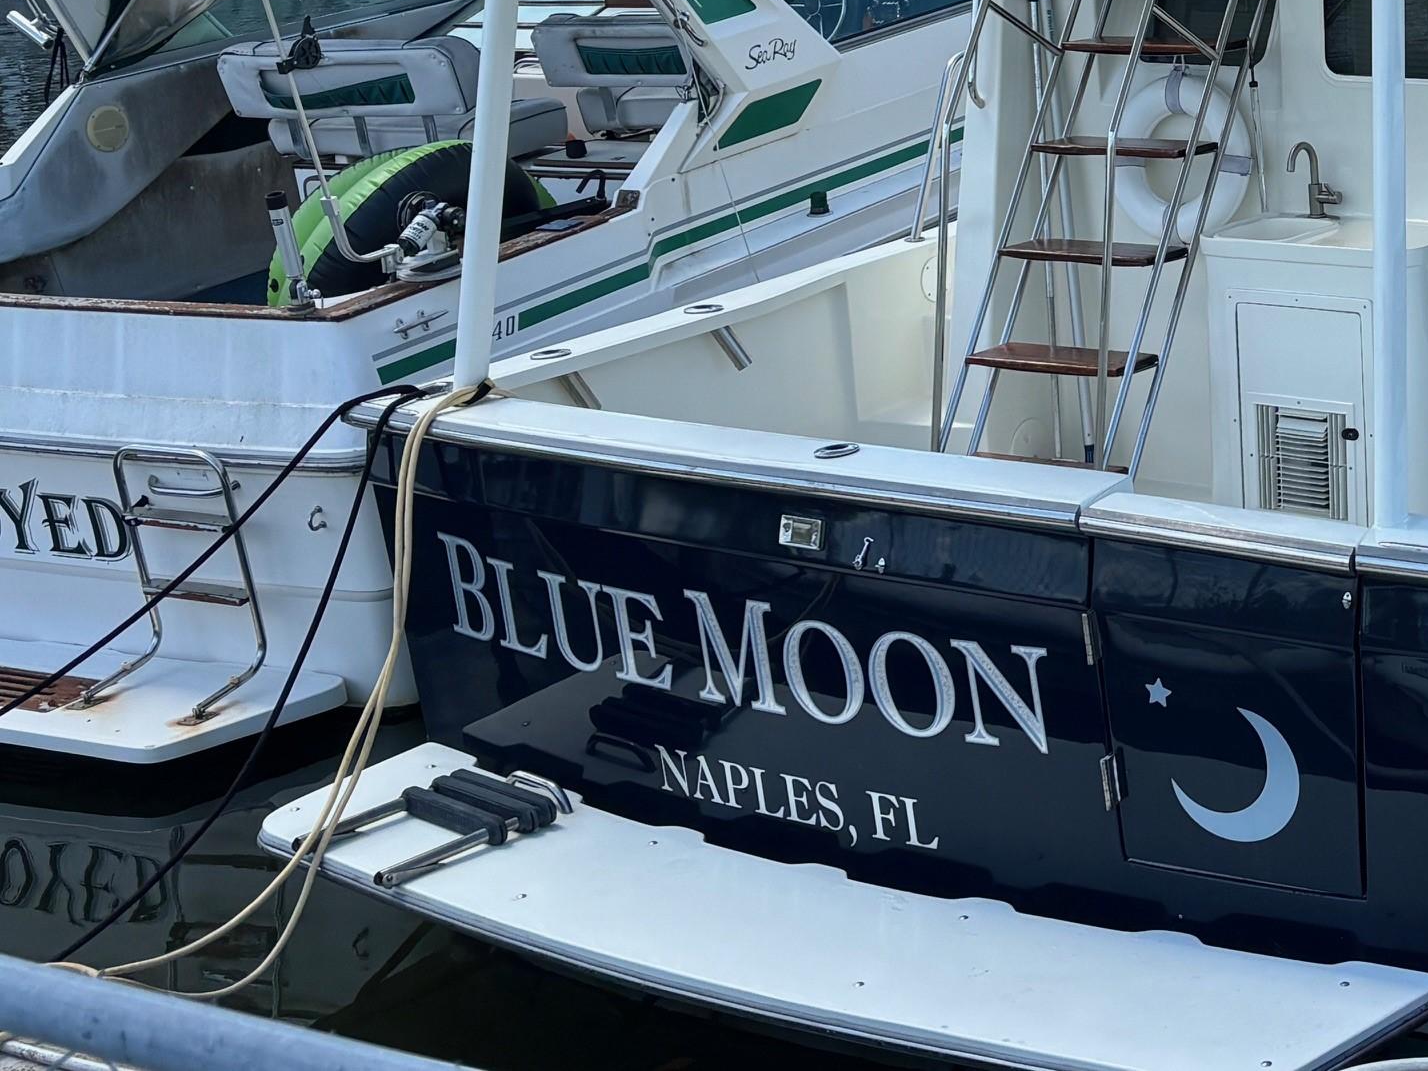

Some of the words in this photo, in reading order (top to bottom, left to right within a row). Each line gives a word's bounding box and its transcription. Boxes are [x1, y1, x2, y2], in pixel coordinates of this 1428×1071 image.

[745, 44, 771, 70] Sea
[768, 38, 797, 61] Ray
[0, 478, 132, 562] YED
[437, 531, 673, 691] BLUE
[683, 589, 1048, 754] MOON
[654, 744, 858, 847] NAPLES,
[866, 790, 939, 850] FL
